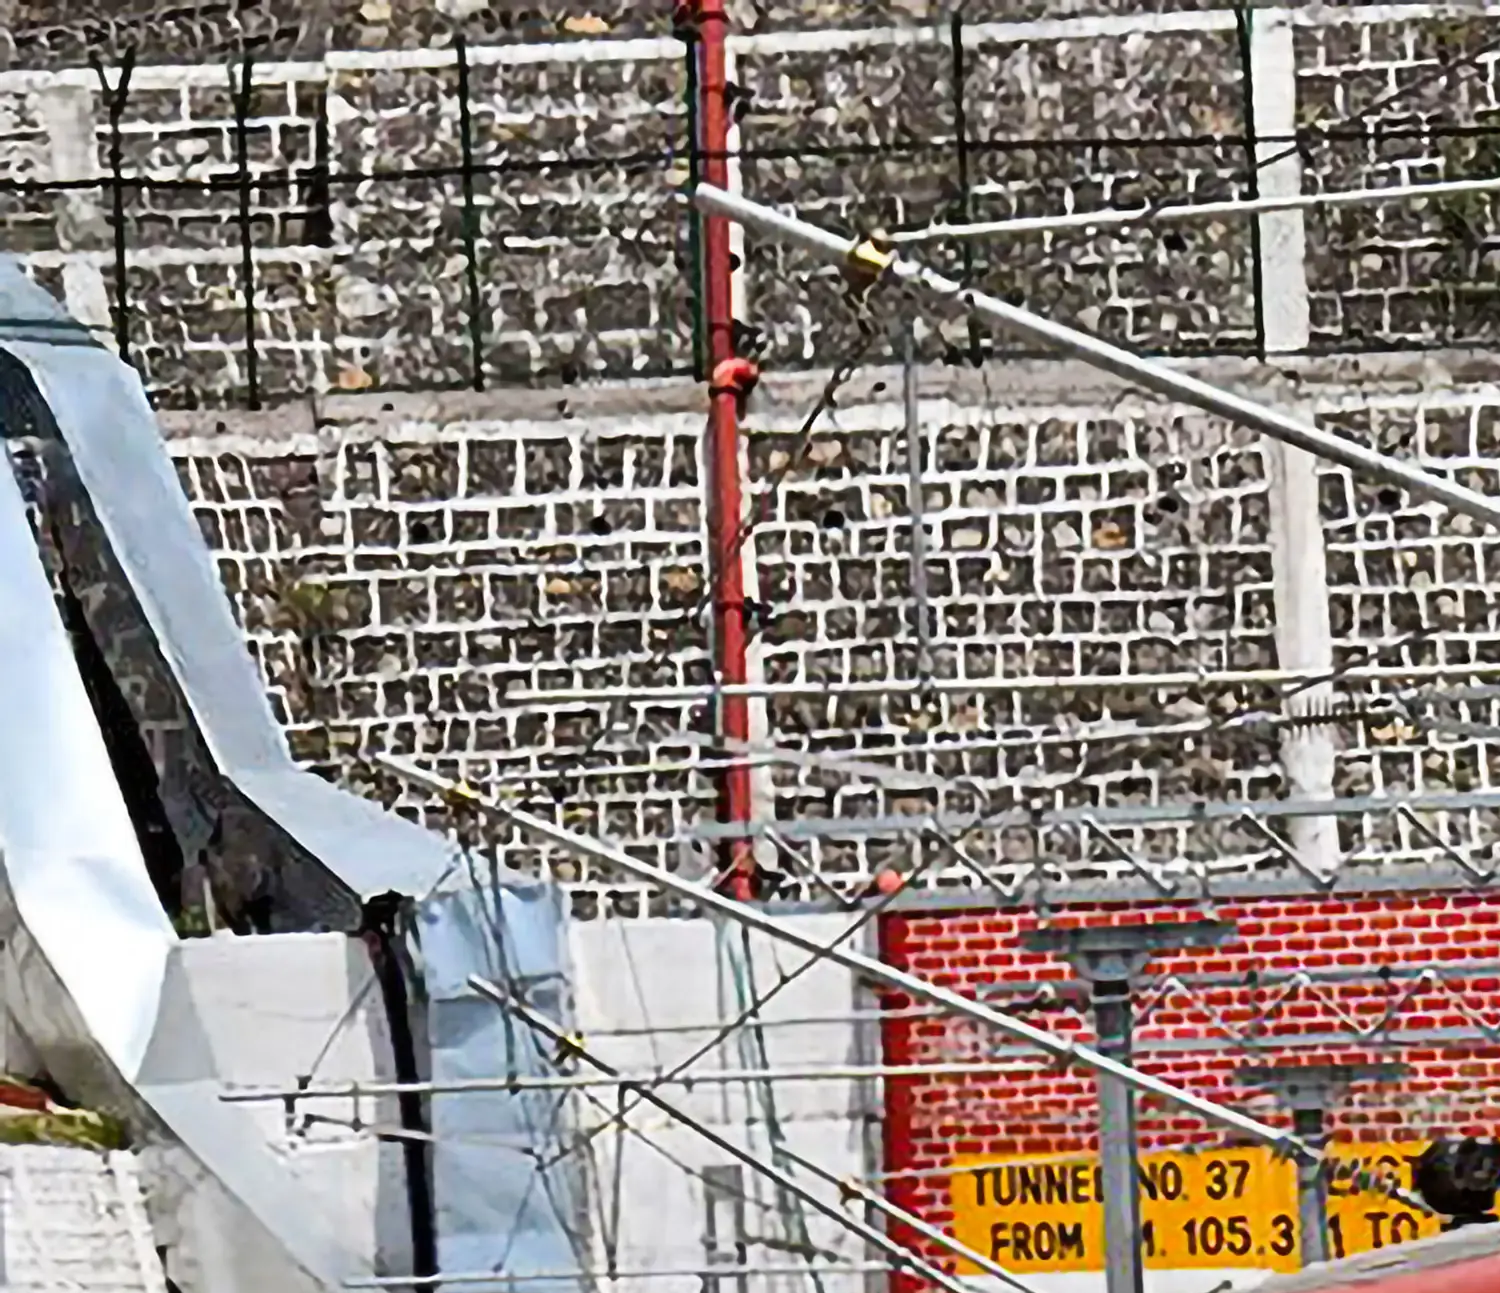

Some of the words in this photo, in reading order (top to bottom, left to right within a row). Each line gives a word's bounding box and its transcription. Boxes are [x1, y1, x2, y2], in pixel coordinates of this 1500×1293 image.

[1204, 1159, 1251, 1201] 37
[989, 1221, 1085, 1262] FROM
[1182, 1213, 1346, 1260] 105.31
[1363, 1211, 1420, 1249] TO
